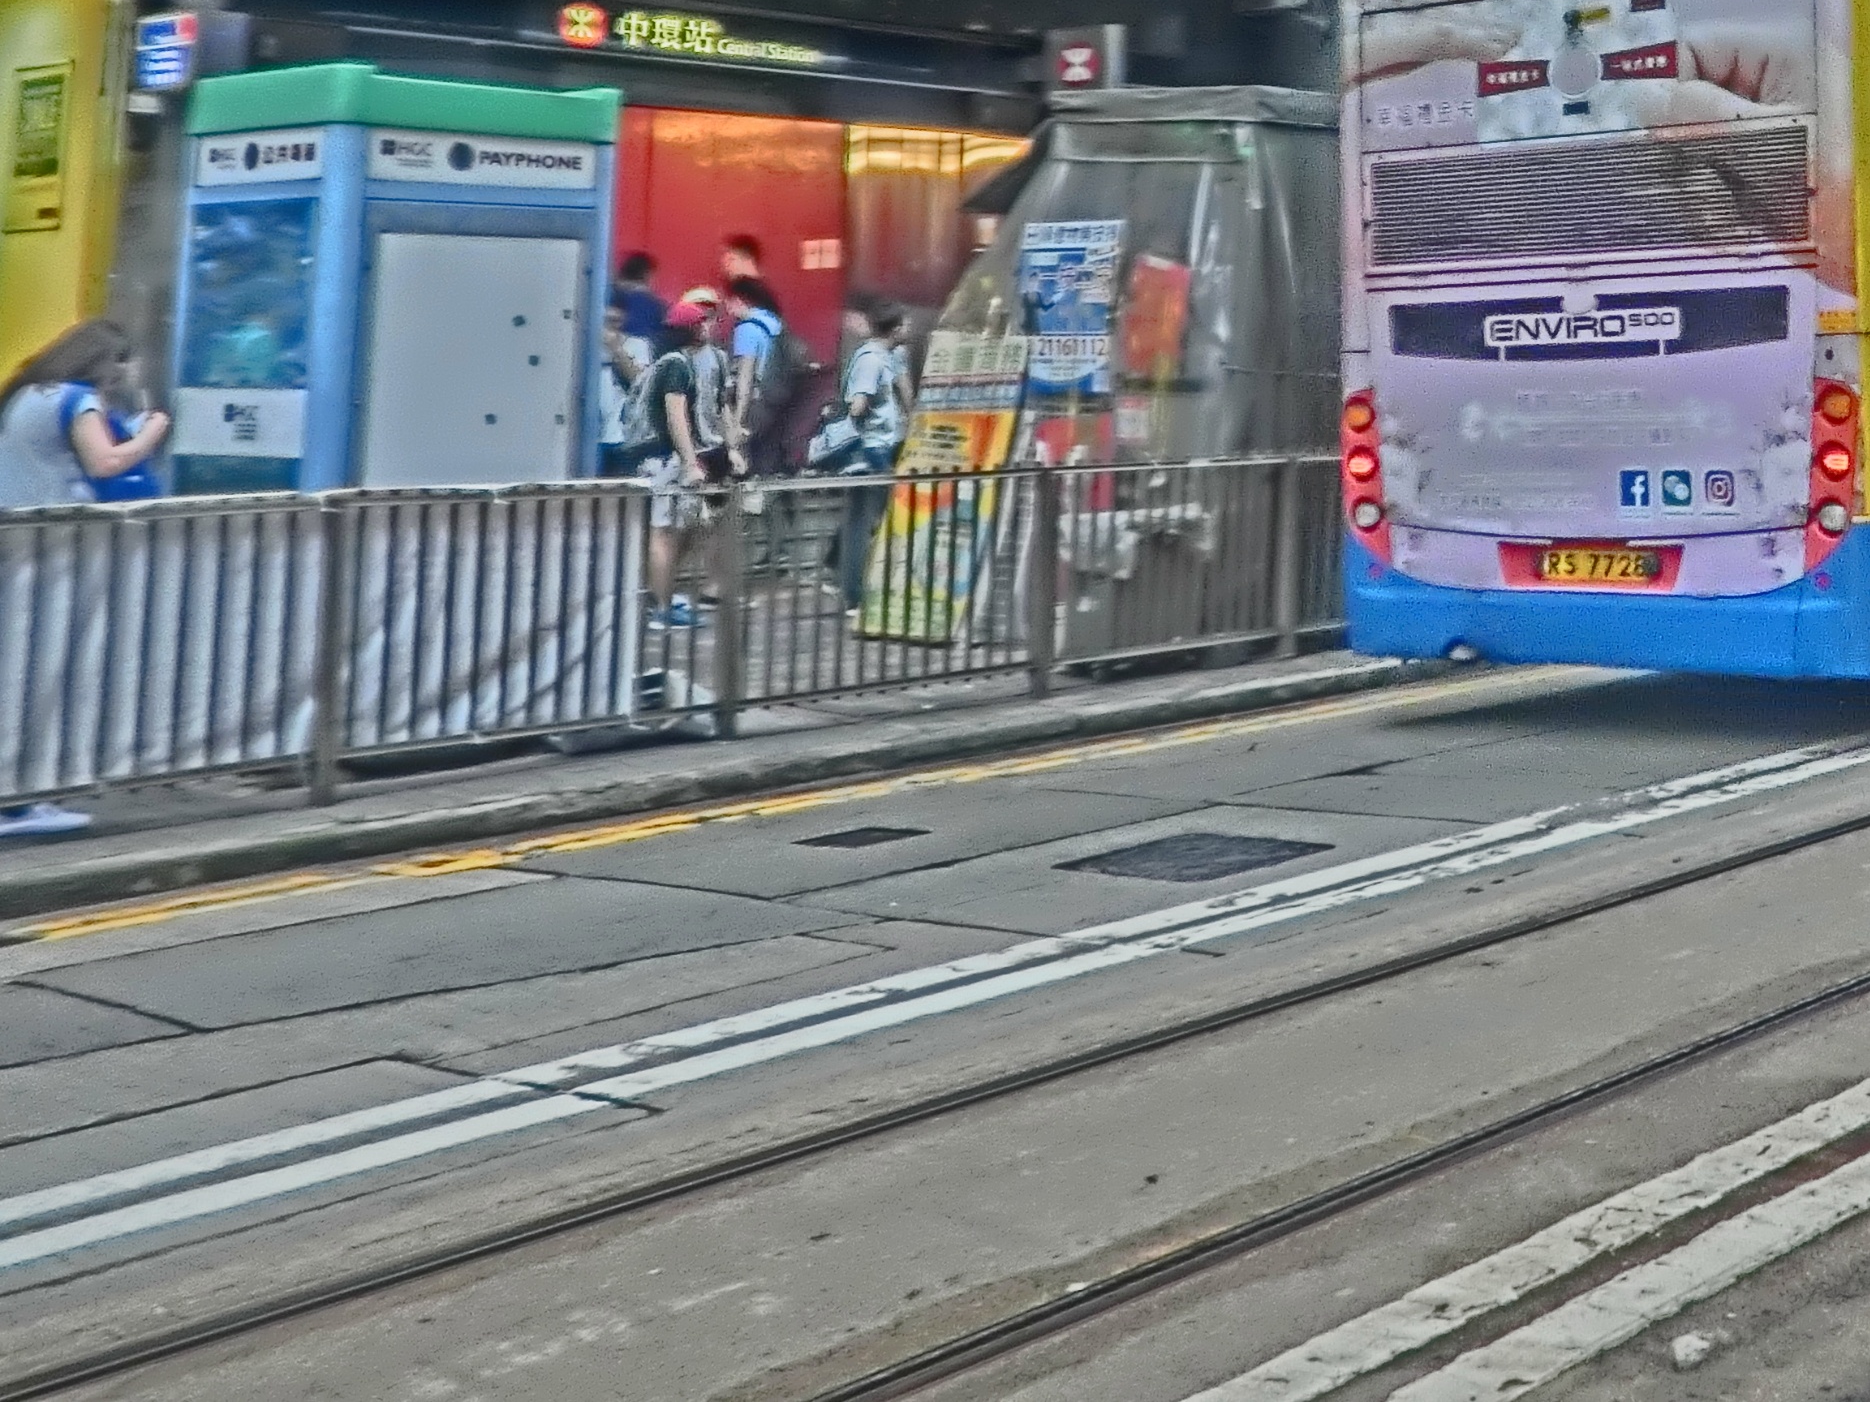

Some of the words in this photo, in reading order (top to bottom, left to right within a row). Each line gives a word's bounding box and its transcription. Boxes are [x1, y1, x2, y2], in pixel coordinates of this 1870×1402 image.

[614, 10, 716, 55] 中環站
[717, 38, 767, 57] Central
[767, 44, 817, 63] Station
[478, 150, 583, 172] PAYPHONE
[1547, 552, 1577, 575] RS
